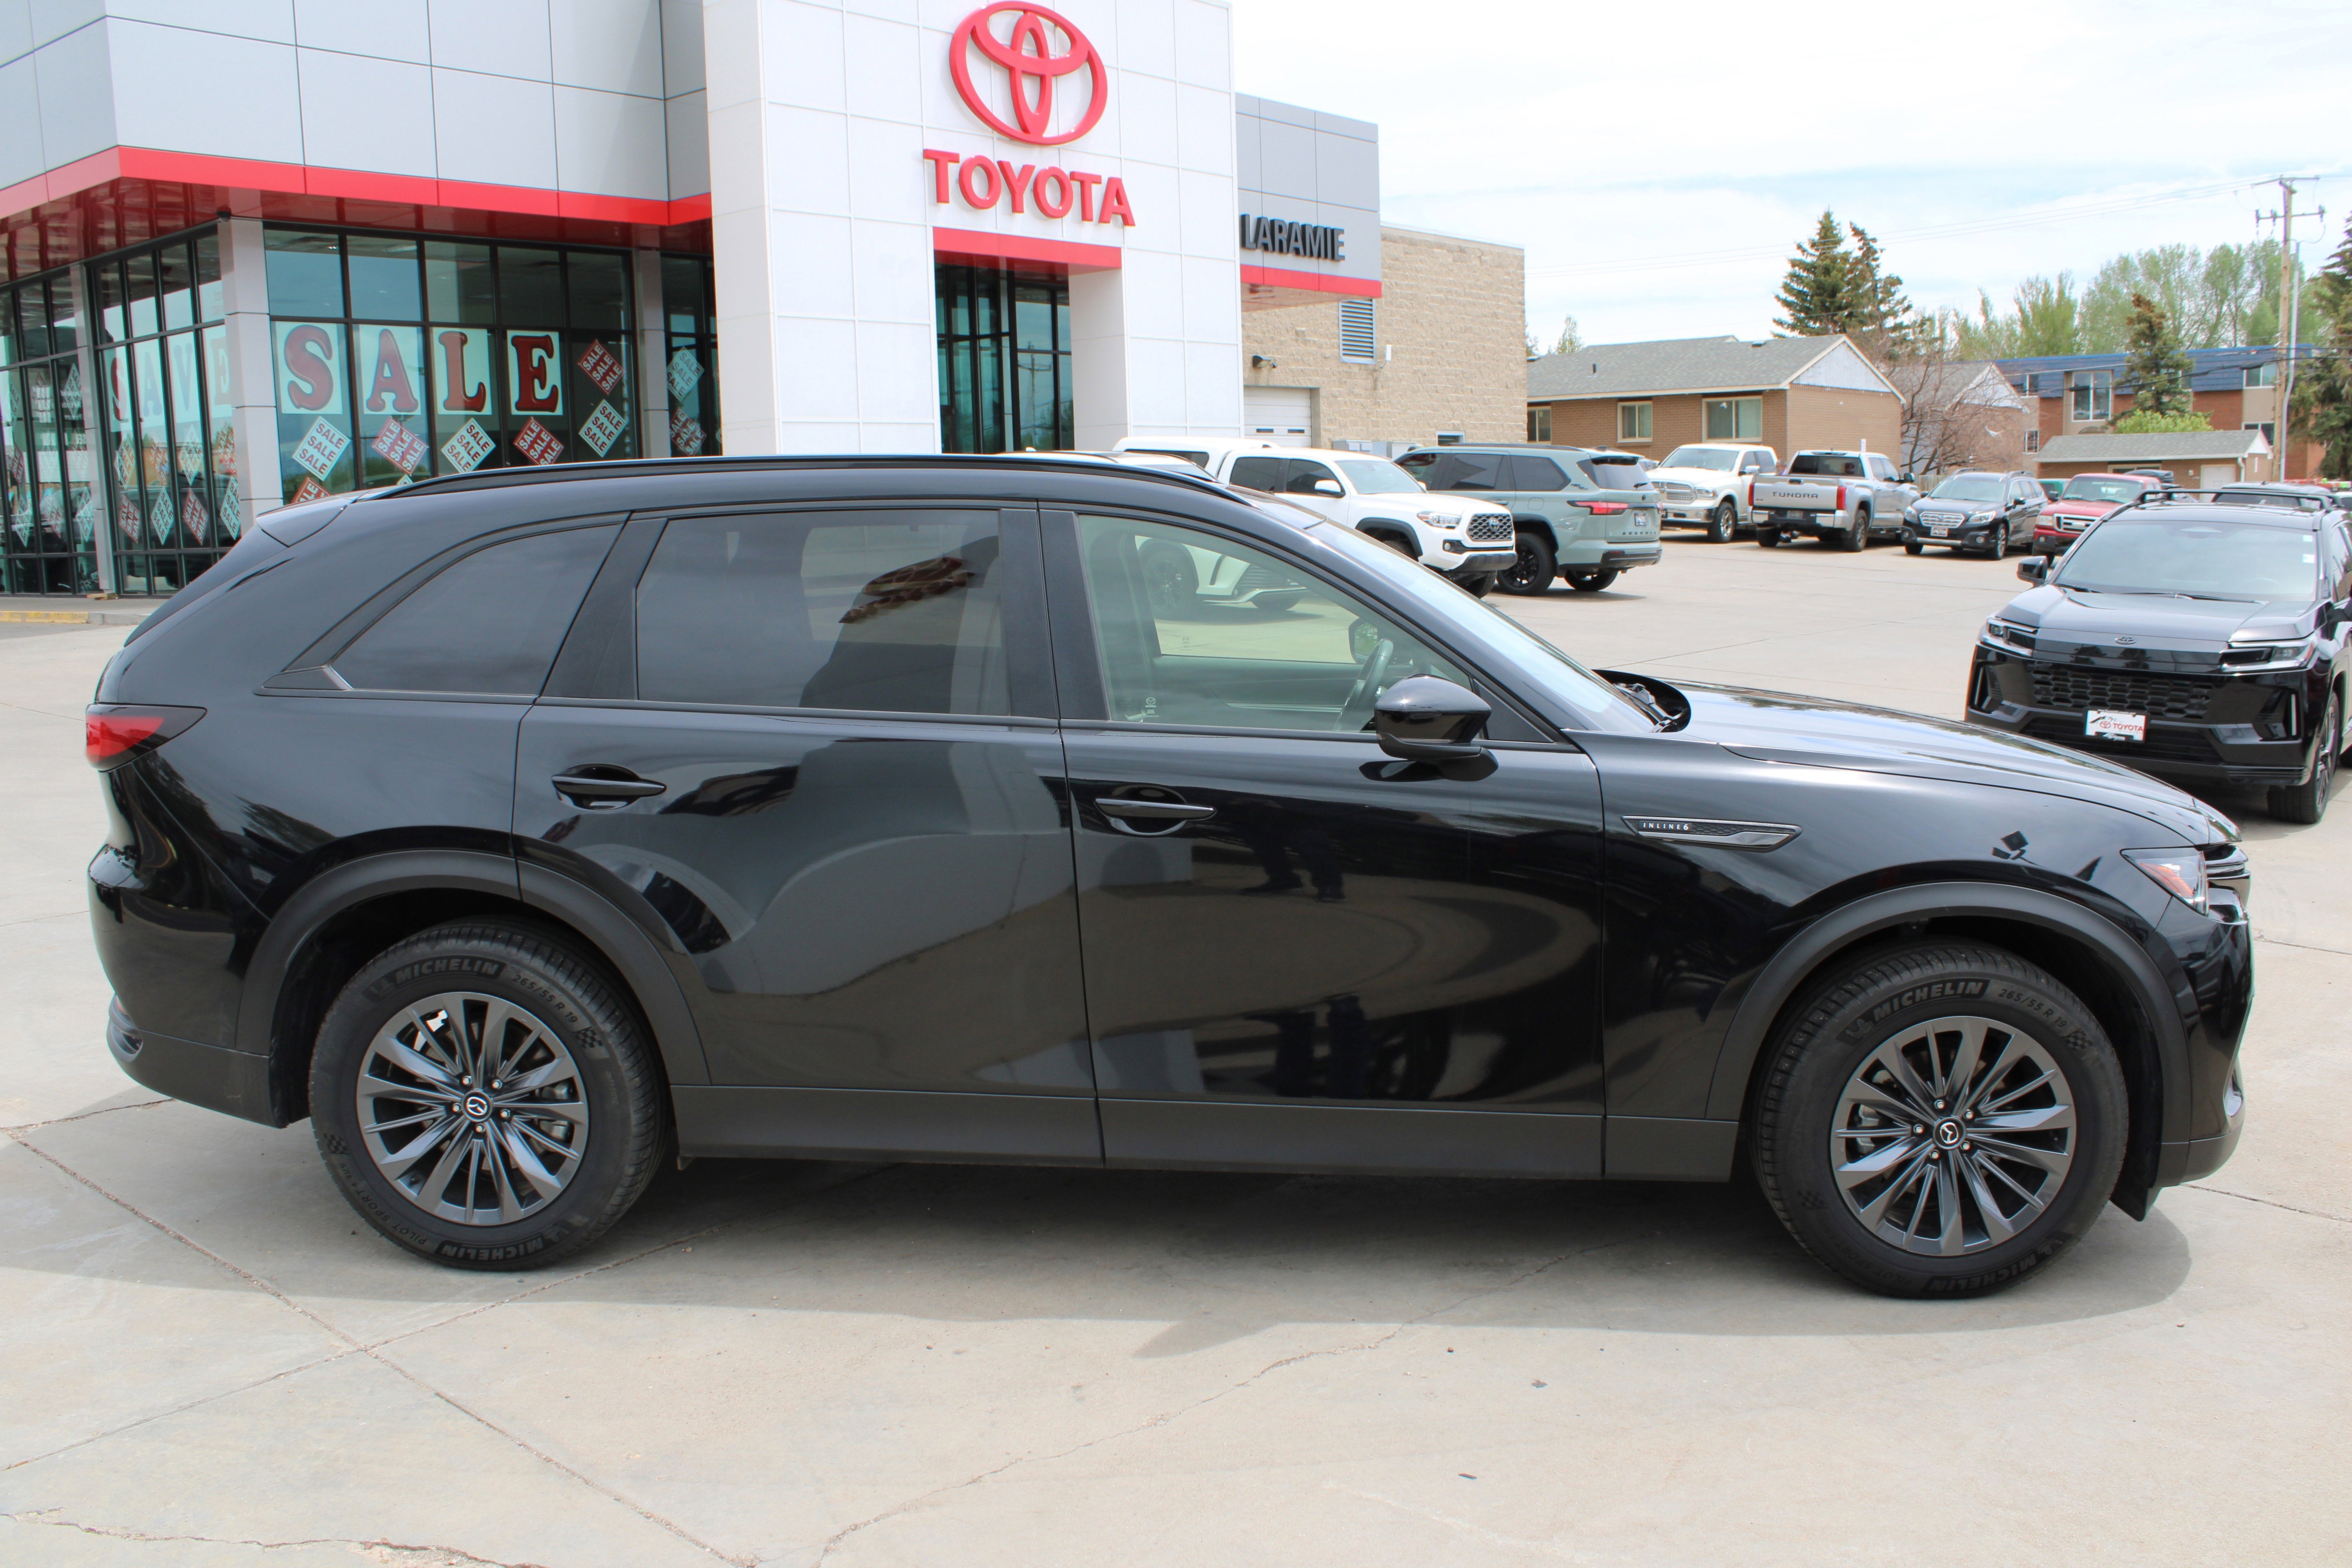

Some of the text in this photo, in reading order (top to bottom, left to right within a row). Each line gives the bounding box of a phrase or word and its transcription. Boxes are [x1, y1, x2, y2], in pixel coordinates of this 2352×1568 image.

[923, 148, 1136, 227] TOYOTA
[1241, 213, 1345, 261] LARAMIE
[284, 324, 559, 412] SALE
[582, 345, 604, 371] SALE
[592, 354, 613, 381] SALE
[679, 352, 701, 376] SALE
[601, 364, 622, 390] SALE
[667, 372, 686, 397] SALE
[672, 362, 693, 387] SALE
[592, 416, 615, 441] SALE
[600, 405, 622, 430] SALE
[670, 412, 686, 438] SALE
[316, 423, 344, 449] SALE
[378, 422, 401, 452] SALE
[390, 432, 413, 461] SALE
[466, 425, 490, 452] SALE
[519, 420, 541, 450] SALE
[530, 431, 551, 459] SALE
[585, 427, 607, 451] SALE
[676, 420, 695, 447] SALE
[685, 429, 704, 456] SALE
[299, 448, 328, 474] SALE
[307, 436, 336, 462] SALE
[402, 441, 424, 470] SALE
[447, 445, 472, 472] SALE
[457, 434, 481, 462] SALE
[540, 441, 561, 465] SALE
[161, 492, 174, 519] SALE
[230, 483, 239, 504] SAL
[157, 503, 169, 529] SALE
[185, 493, 195, 522] SALE
[191, 501, 201, 531] SALE
[223, 508, 237, 533] SALE
[227, 495, 241, 521] SALE
[153, 512, 165, 539] SALE
[197, 510, 207, 540] SALE
[2113, 723, 2144, 731] TOYOTA
[396, 959, 499, 984] MICHELIN
[512, 975, 578, 1023] 265/55 R 19
[1873, 982, 1983, 1022] MICHELIN
[1998, 989, 2067, 1027] 265/55 R 19
[339, 1163, 353, 1180] SUV
[355, 1189, 391, 1221] SPORT
[392, 1223, 428, 1245] PILOT
[440, 1237, 544, 1260] MICHELIN
[1835, 1242, 1874, 1270] SPORT
[1875, 1269, 1913, 1286] PILOT
[1928, 1253, 2037, 1292] MICHELIN
